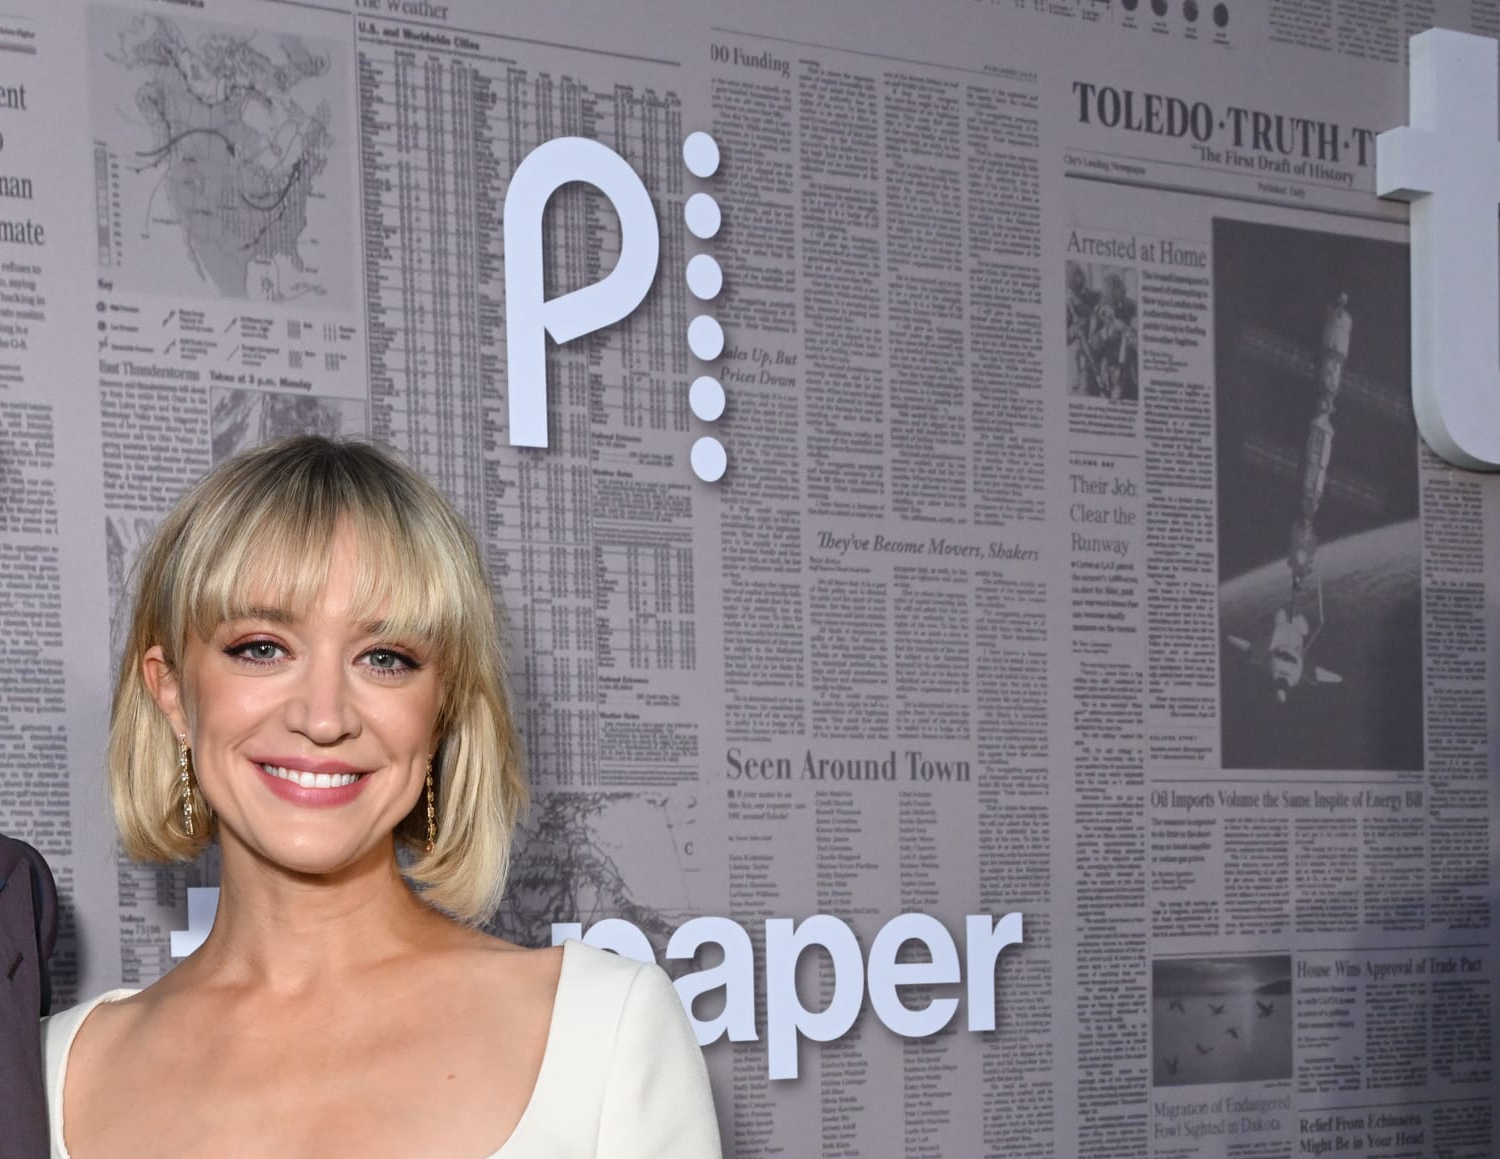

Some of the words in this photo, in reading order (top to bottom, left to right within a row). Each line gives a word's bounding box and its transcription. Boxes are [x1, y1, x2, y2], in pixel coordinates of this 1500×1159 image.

[1225, 150, 1255, 169] First
[1258, 154, 1291, 175] Draft
[1293, 159, 1308, 177] of
[1309, 163, 1355, 188] History
[1066, 229, 1137, 261] Arrested
[1140, 243, 1155, 263] at
[1159, 240, 1207, 268] Home
[720, 365, 757, 384] Prices
[759, 369, 797, 388] Down
[1069, 474, 1109, 496] Their
[1069, 502, 1110, 524] Clear
[1113, 505, 1137, 526] the
[874, 533, 925, 555] Become
[928, 536, 985, 561] Movers,
[987, 541, 1040, 562] Shakers
[1071, 531, 1131, 558] Runway
[726, 747, 792, 781] Seen
[800, 749, 898, 782] Around
[904, 750, 971, 782] Town
[1150, 790, 1168, 809] Oil
[1171, 790, 1216, 813] Imports
[1218, 790, 1261, 809] Volume
[1262, 790, 1280, 809] the
[1281, 790, 1312, 809] Same
[1313, 790, 1350, 813] Inspite
[1351, 790, 1363, 809] of
[1365, 790, 1401, 813] Energy
[1404, 789, 1424, 809] Bill
[1297, 960, 1332, 979] House
[1334, 959, 1362, 978] Wins
[1365, 958, 1413, 981] Approval
[1415, 957, 1427, 974] of
[1429, 956, 1458, 974] Trade
[1460, 956, 1482, 974] Pact
[1154, 1101, 1209, 1121] Migration
[1210, 1100, 1223, 1114] of
[1225, 1096, 1292, 1115] Endangered
[1154, 1121, 1181, 1139] Fowl
[1183, 1119, 1226, 1138] Sighted
[1227, 1121, 1239, 1134] in
[1241, 1116, 1282, 1133] Dakota
[1300, 1115, 1333, 1134] Relief
[1335, 1114, 1365, 1132] From
[1367, 1112, 1422, 1129] Echinacea
[1300, 1137, 1333, 1157] Might
[1336, 1135, 1349, 1151] Be
[1352, 1134, 1364, 1150] in
[1366, 1133, 1393, 1149] Your
[1395, 1130, 1424, 1147] Head
